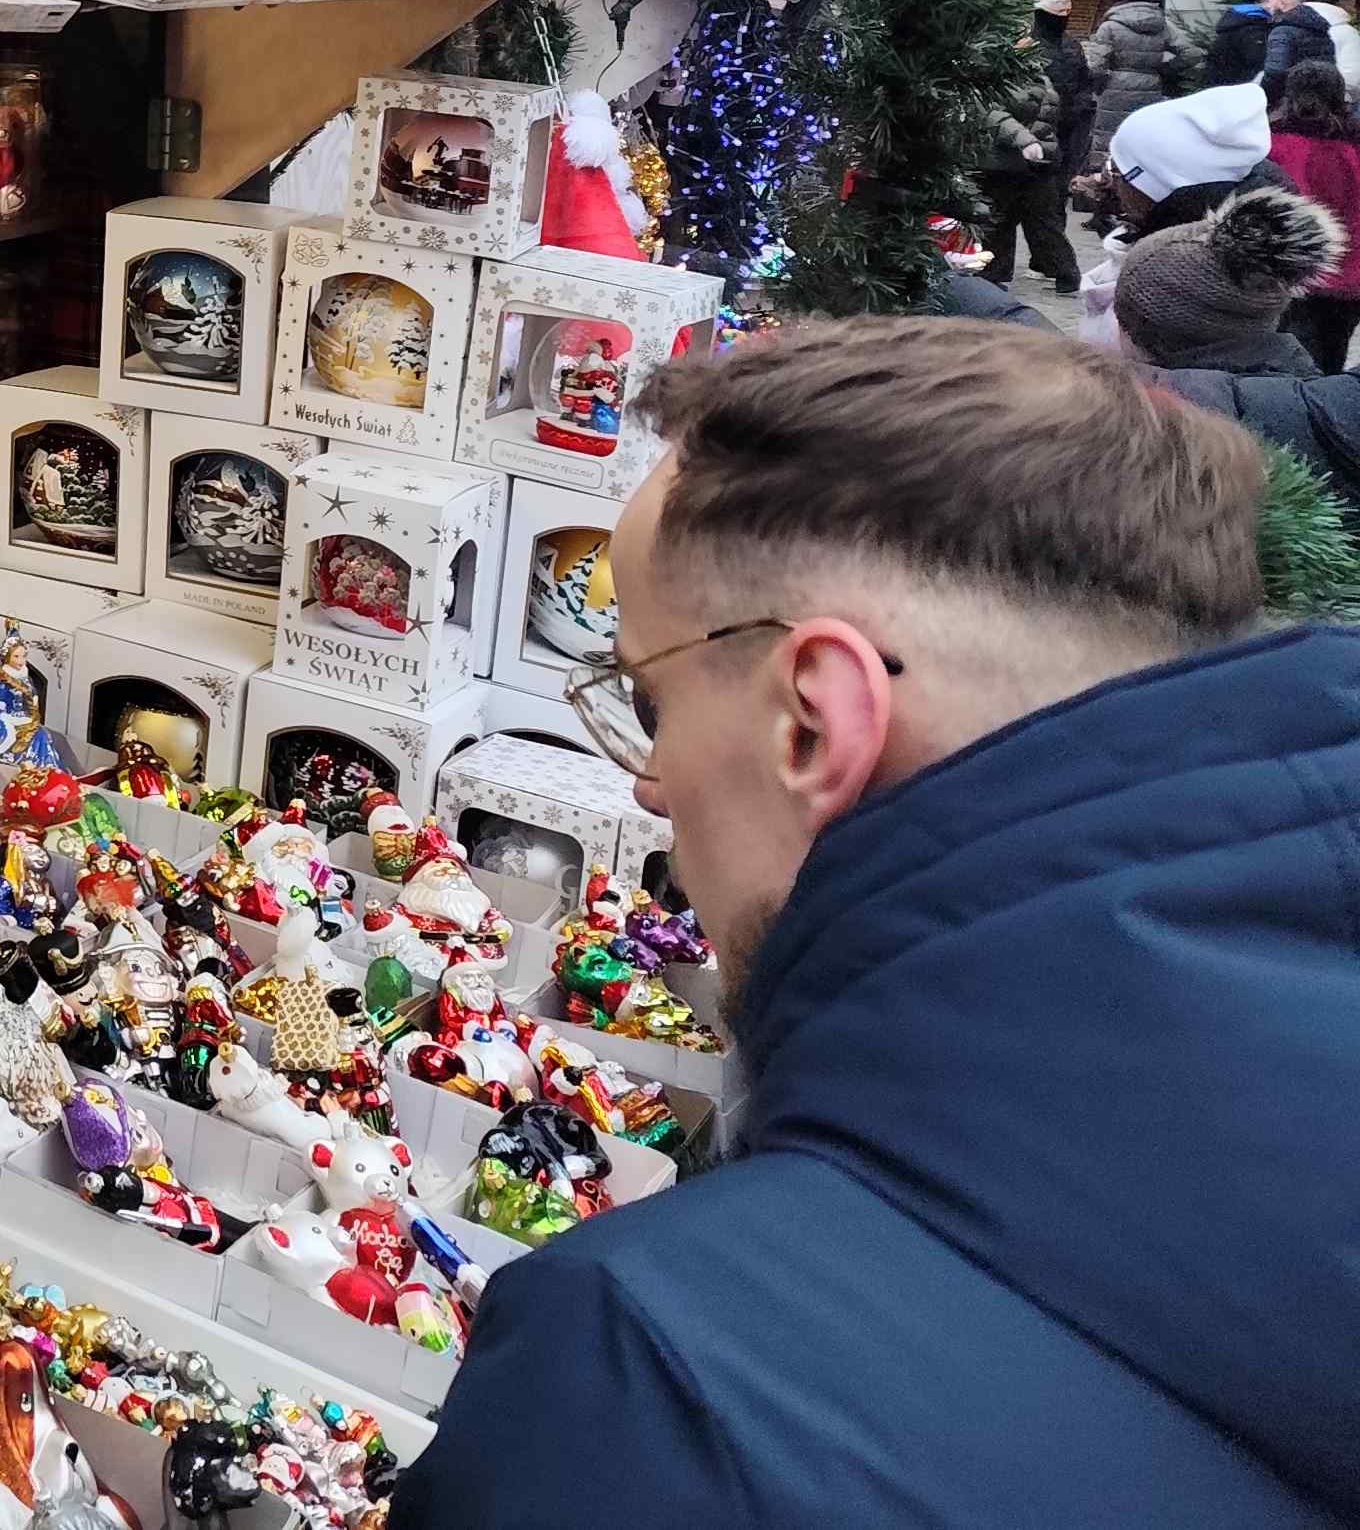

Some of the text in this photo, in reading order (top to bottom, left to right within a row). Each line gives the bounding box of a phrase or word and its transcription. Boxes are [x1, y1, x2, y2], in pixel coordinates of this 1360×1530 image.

[295, 403, 351, 429] Wesołych
[183, 591, 266, 615] MADE IN POLAND
[283, 628, 420, 677] WESOŁYCH
[308, 656, 389, 694] ŚWIĄT
